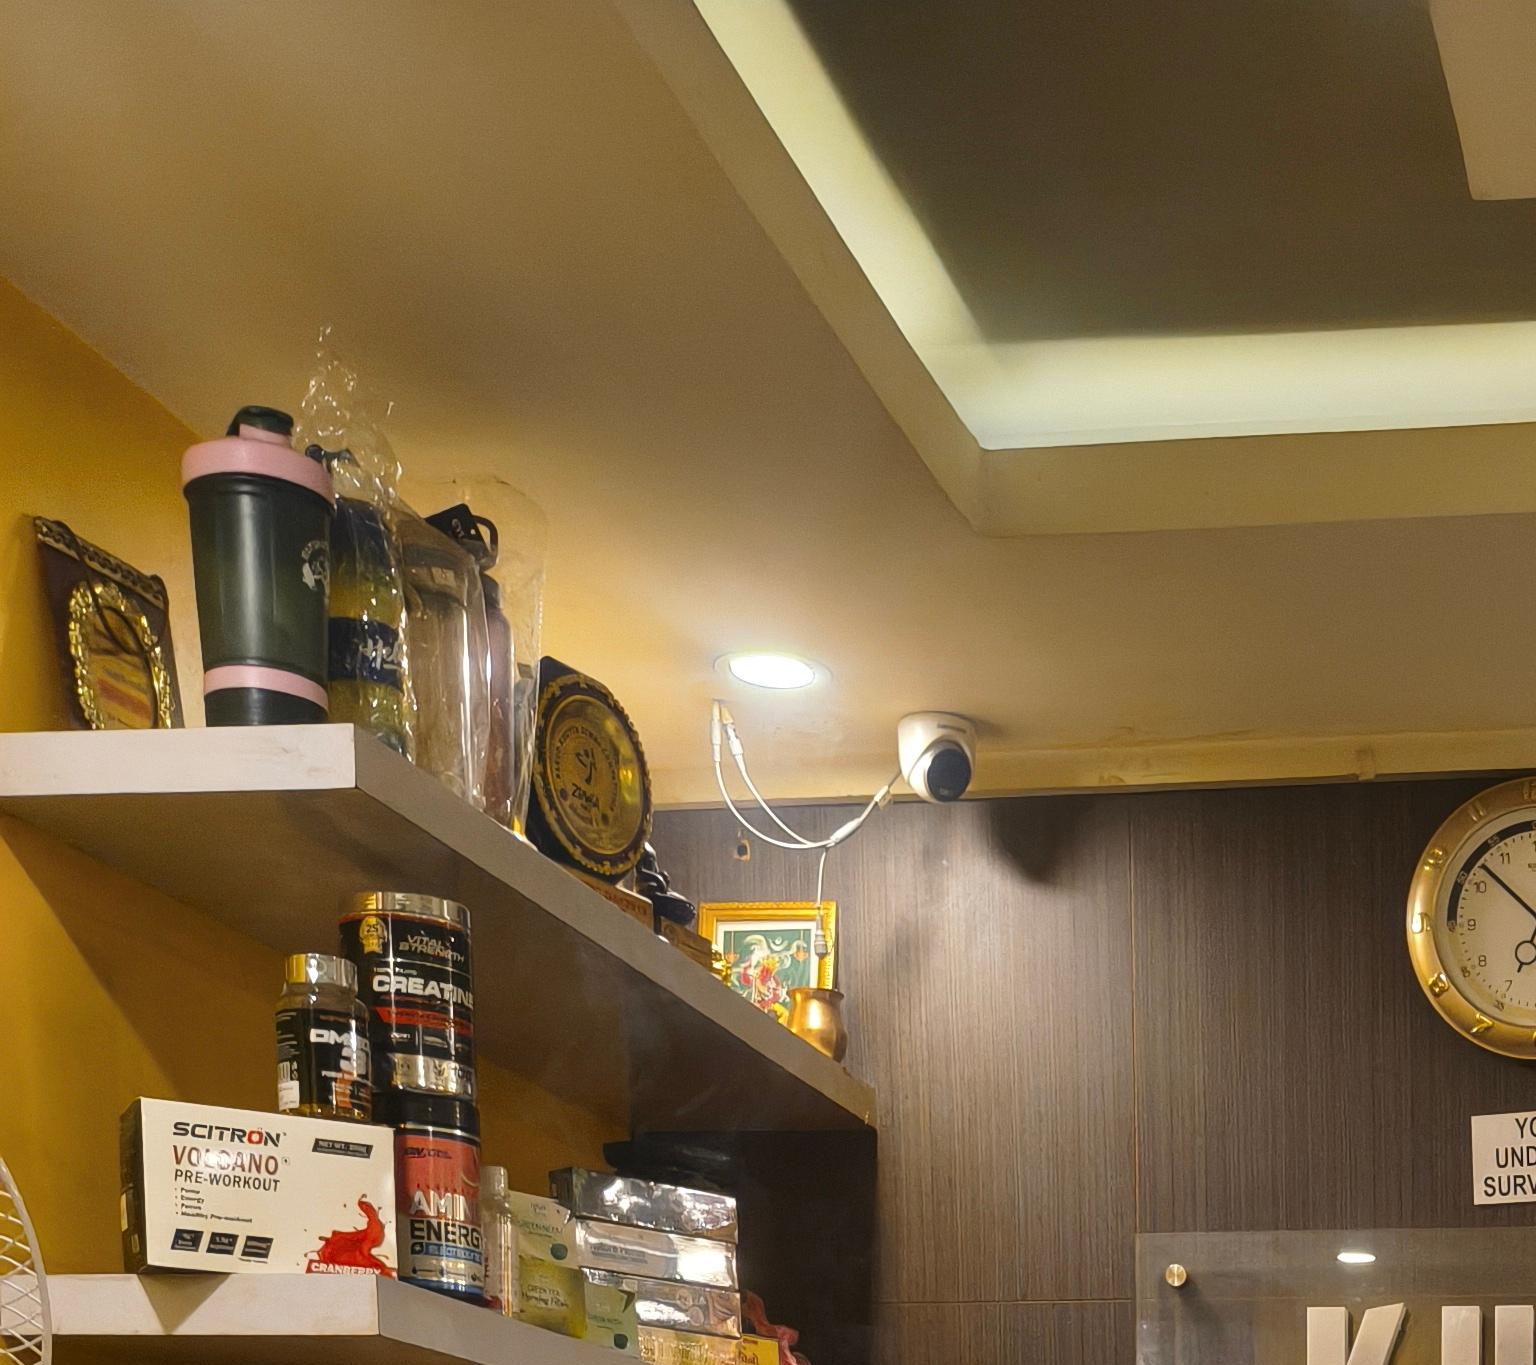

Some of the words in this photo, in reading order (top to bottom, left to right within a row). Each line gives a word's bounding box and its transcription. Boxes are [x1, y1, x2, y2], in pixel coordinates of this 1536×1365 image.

[1500, 853, 1511, 865] 11
[1474, 881, 1487, 894] 10
[1467, 918, 1476, 930] 9
[1478, 955, 1487, 967] 8
[1504, 980, 1513, 992] 7
[172, 1121, 281, 1148] SCITRON
[172, 1144, 279, 1176] VOLCANO
[174, 1168, 281, 1193] PRE-WORKOUT
[410, 1219, 482, 1250] ENERG
[311, 1262, 382, 1276] CRANBERRY
